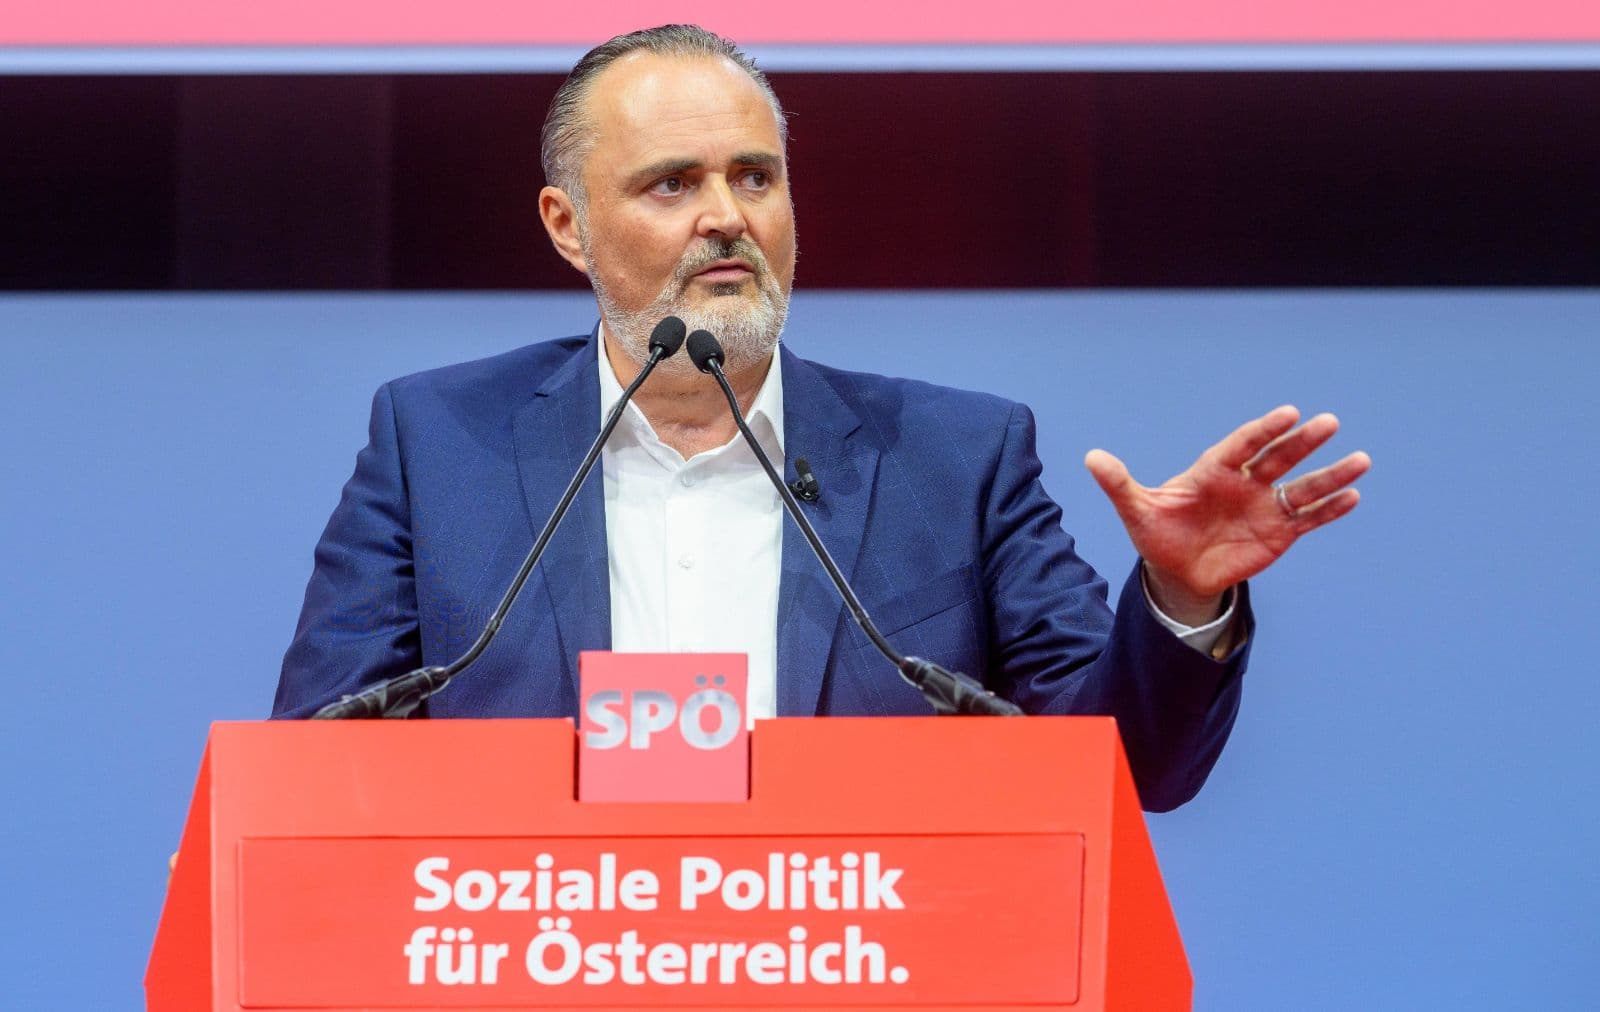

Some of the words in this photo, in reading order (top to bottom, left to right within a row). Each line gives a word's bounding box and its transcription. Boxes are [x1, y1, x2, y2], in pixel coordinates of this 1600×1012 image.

[584, 674, 742, 751] SPÖ
[413, 853, 660, 912] Soziale
[680, 851, 906, 911] Politik
[403, 925, 510, 986] für
[525, 916, 910, 986] Österreich.
